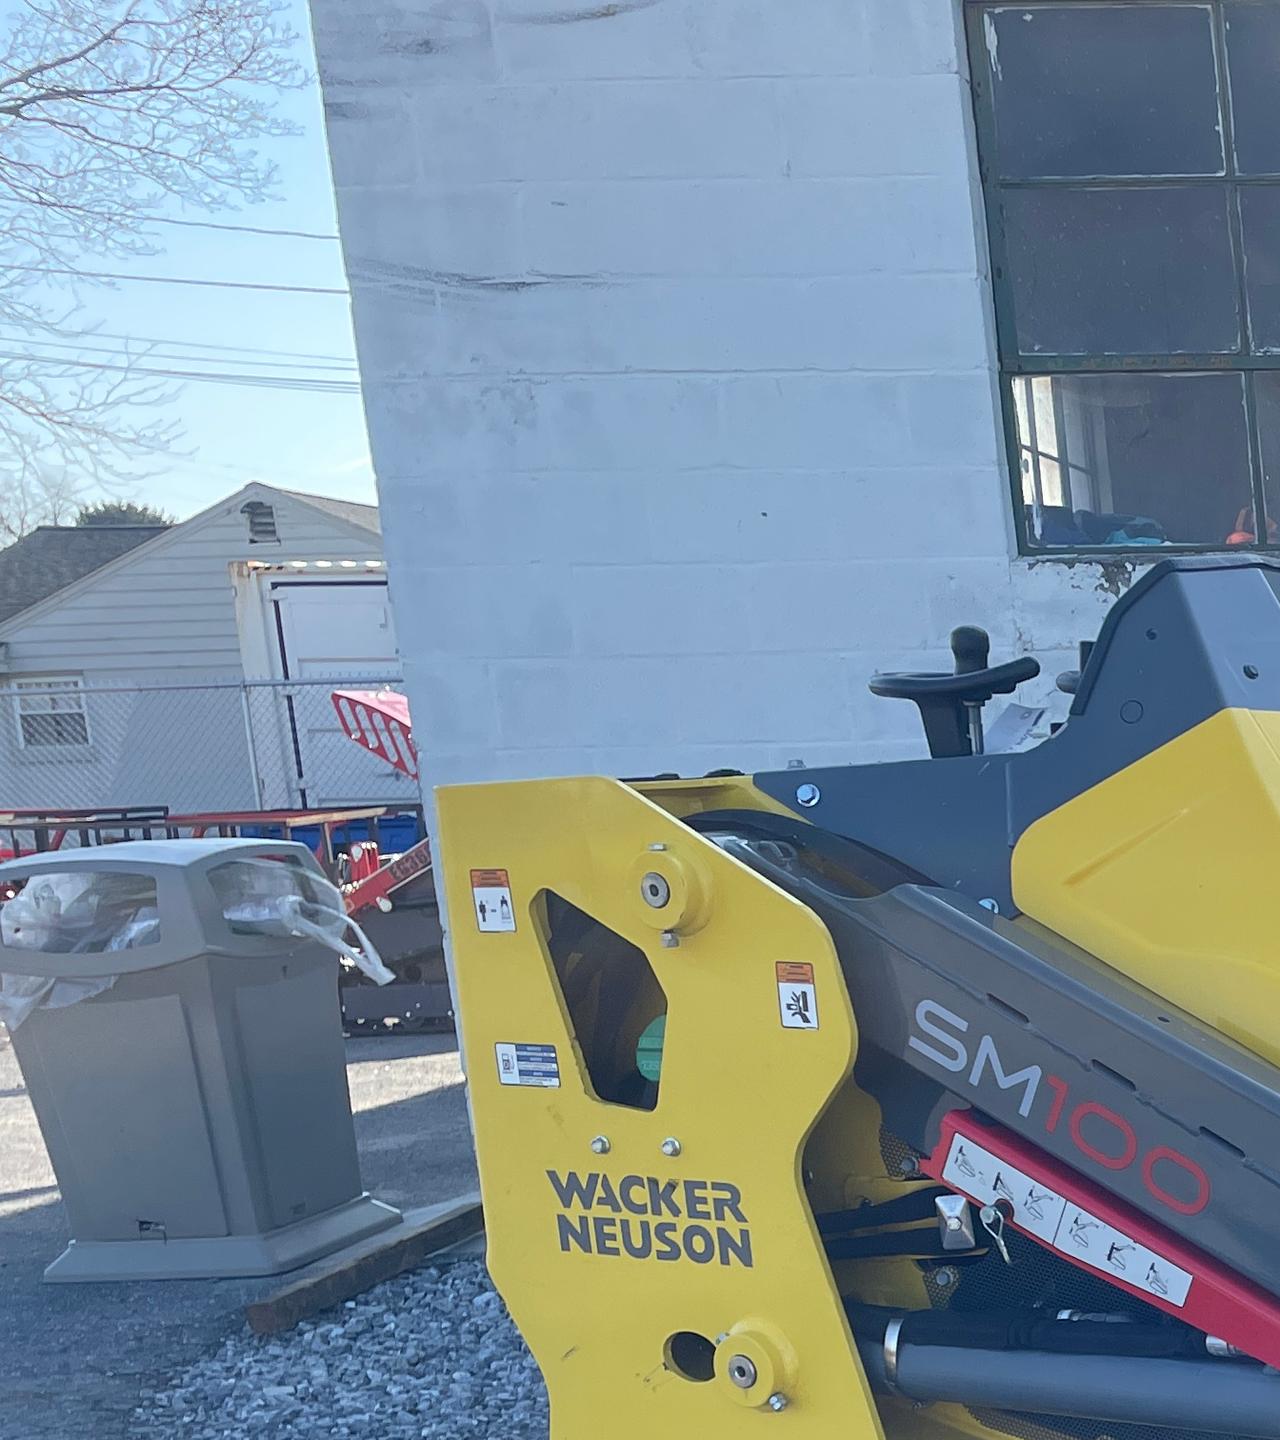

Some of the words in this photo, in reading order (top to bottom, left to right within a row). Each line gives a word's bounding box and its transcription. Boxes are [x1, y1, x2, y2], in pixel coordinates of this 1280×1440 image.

[908, 999, 1212, 1217] SM100
[546, 1169, 748, 1223] WACKER
[556, 1213, 754, 1268] NEUSON
